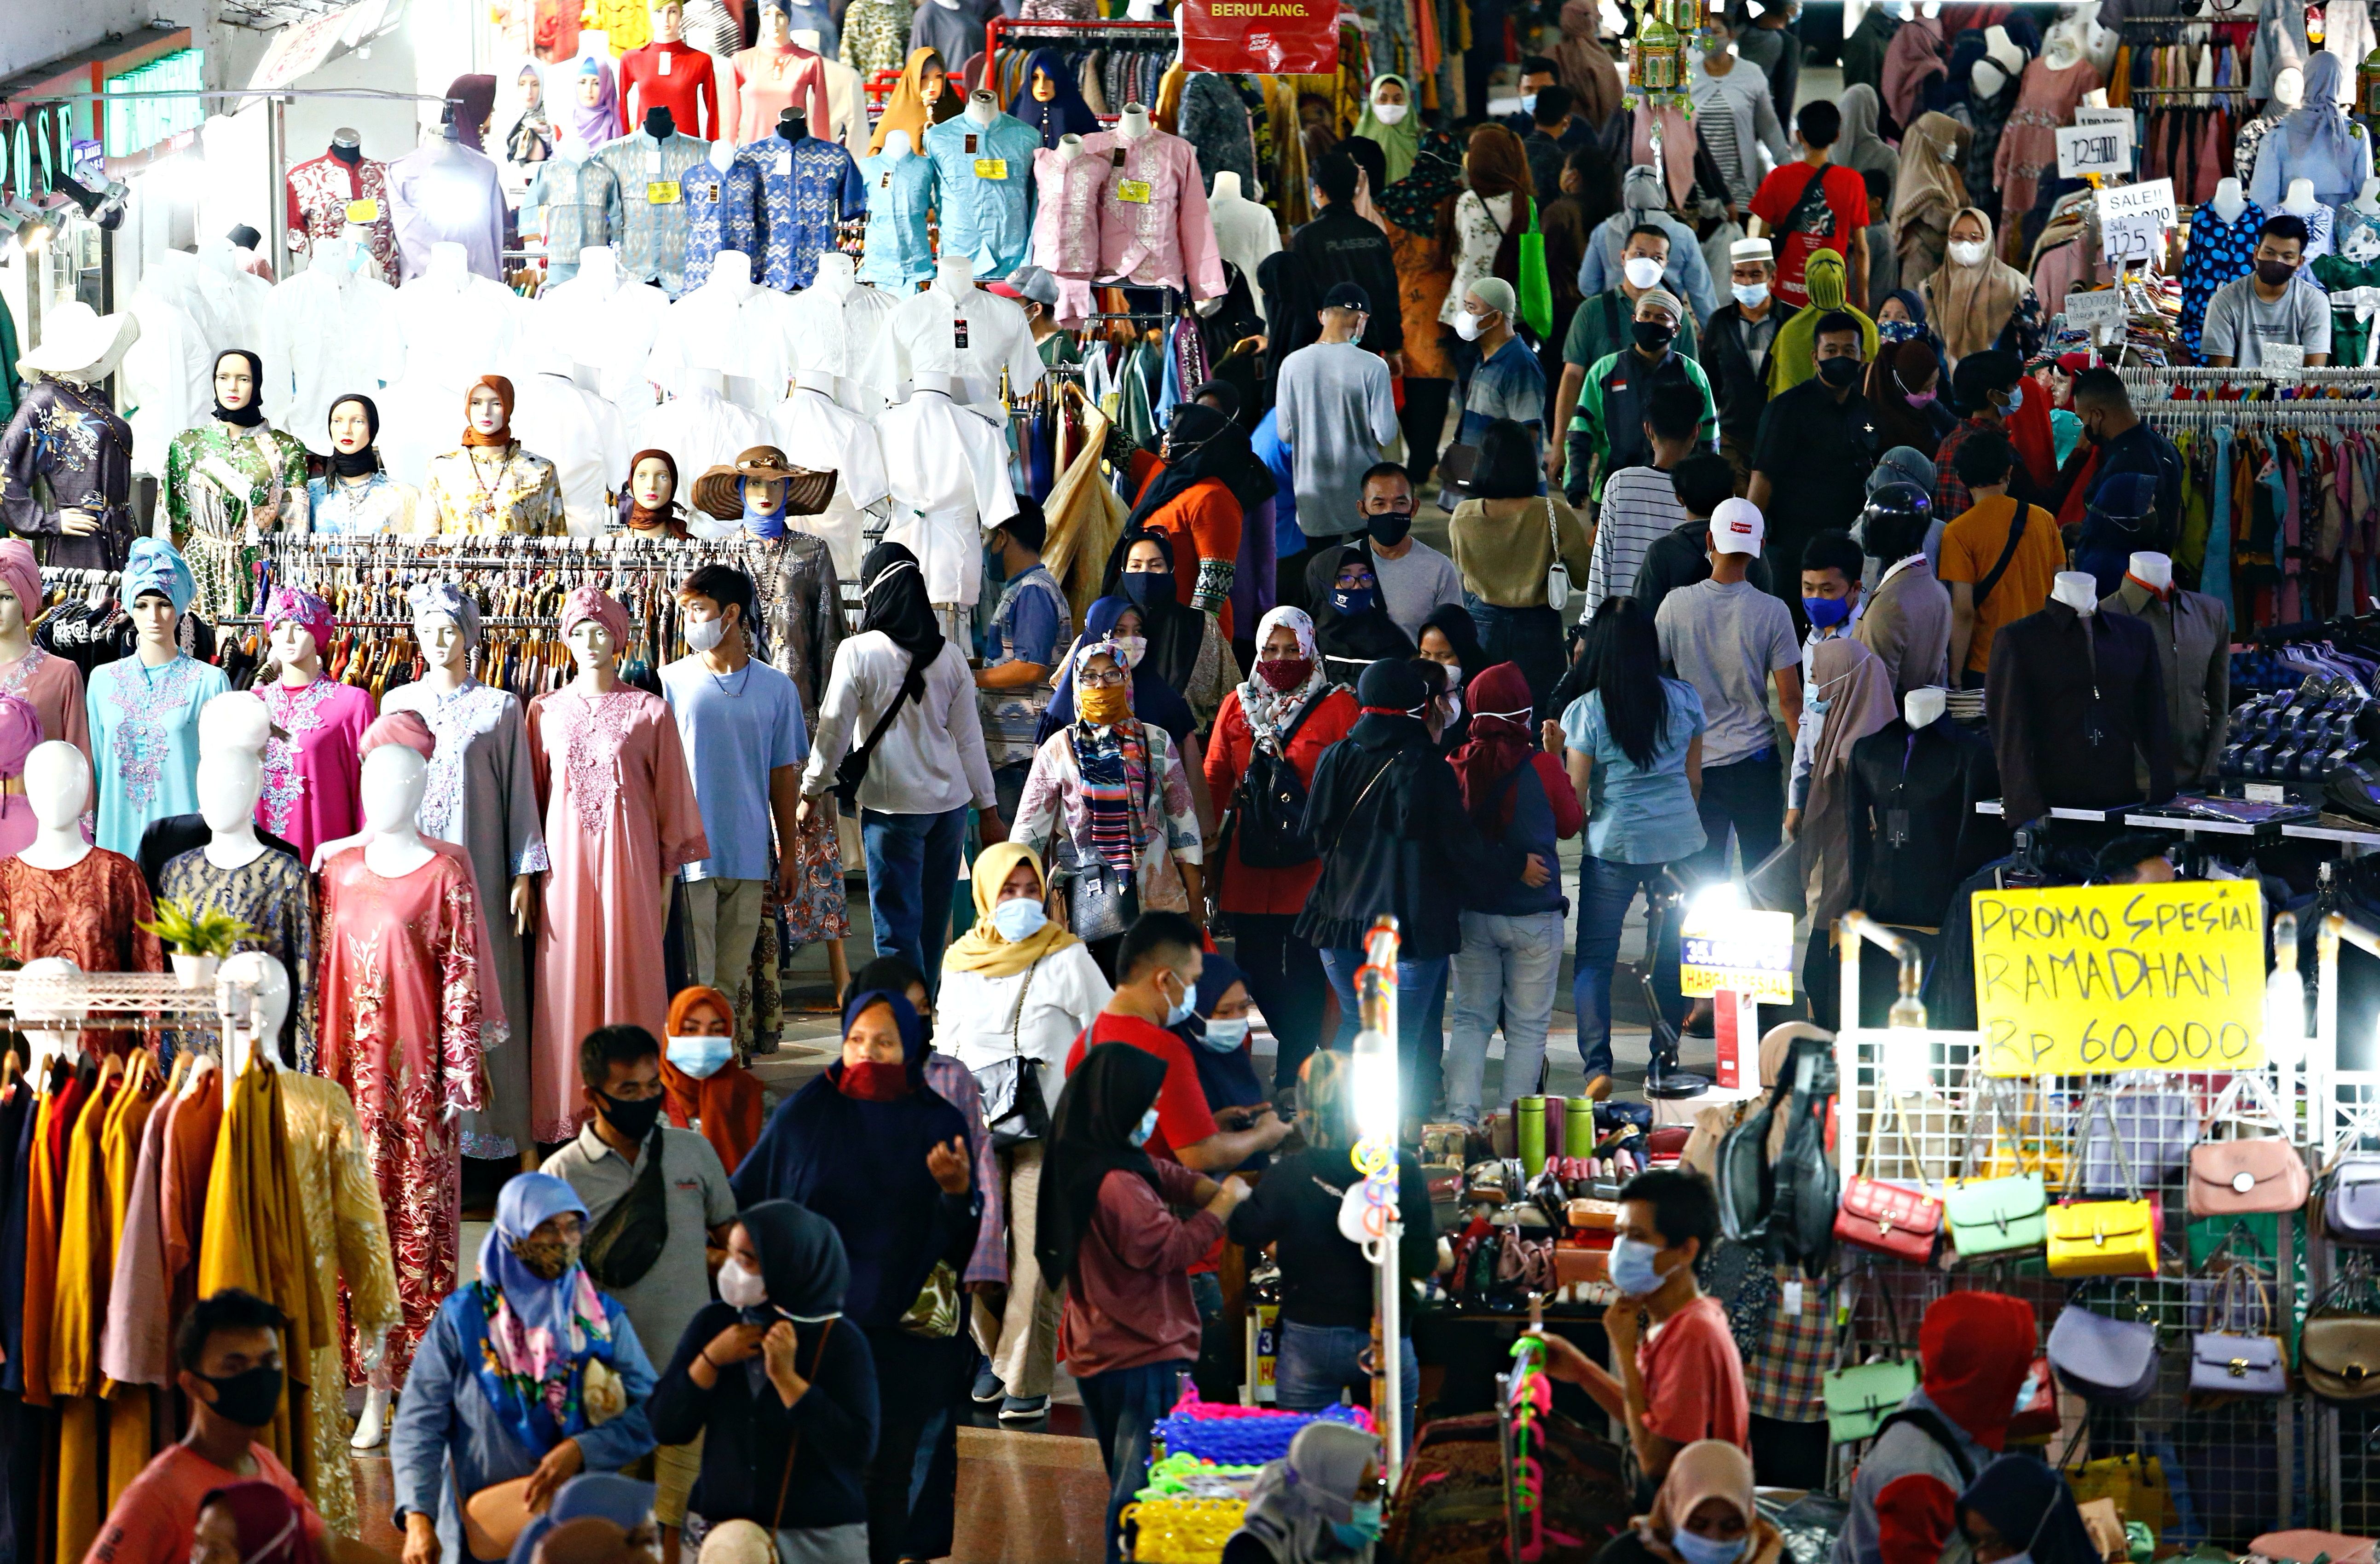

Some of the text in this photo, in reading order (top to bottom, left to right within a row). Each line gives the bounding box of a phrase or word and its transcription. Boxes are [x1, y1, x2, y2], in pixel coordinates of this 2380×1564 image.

[1211, 3, 1309, 17] BERULANG.
[2110, 189, 2162, 209] SALE!!
[2109, 229, 2147, 256] 125
[1978, 899, 2109, 943] PROMO
[1983, 948, 2230, 1002] RAMADHAN
[1989, 1018, 2249, 1065] Rp 60.000
